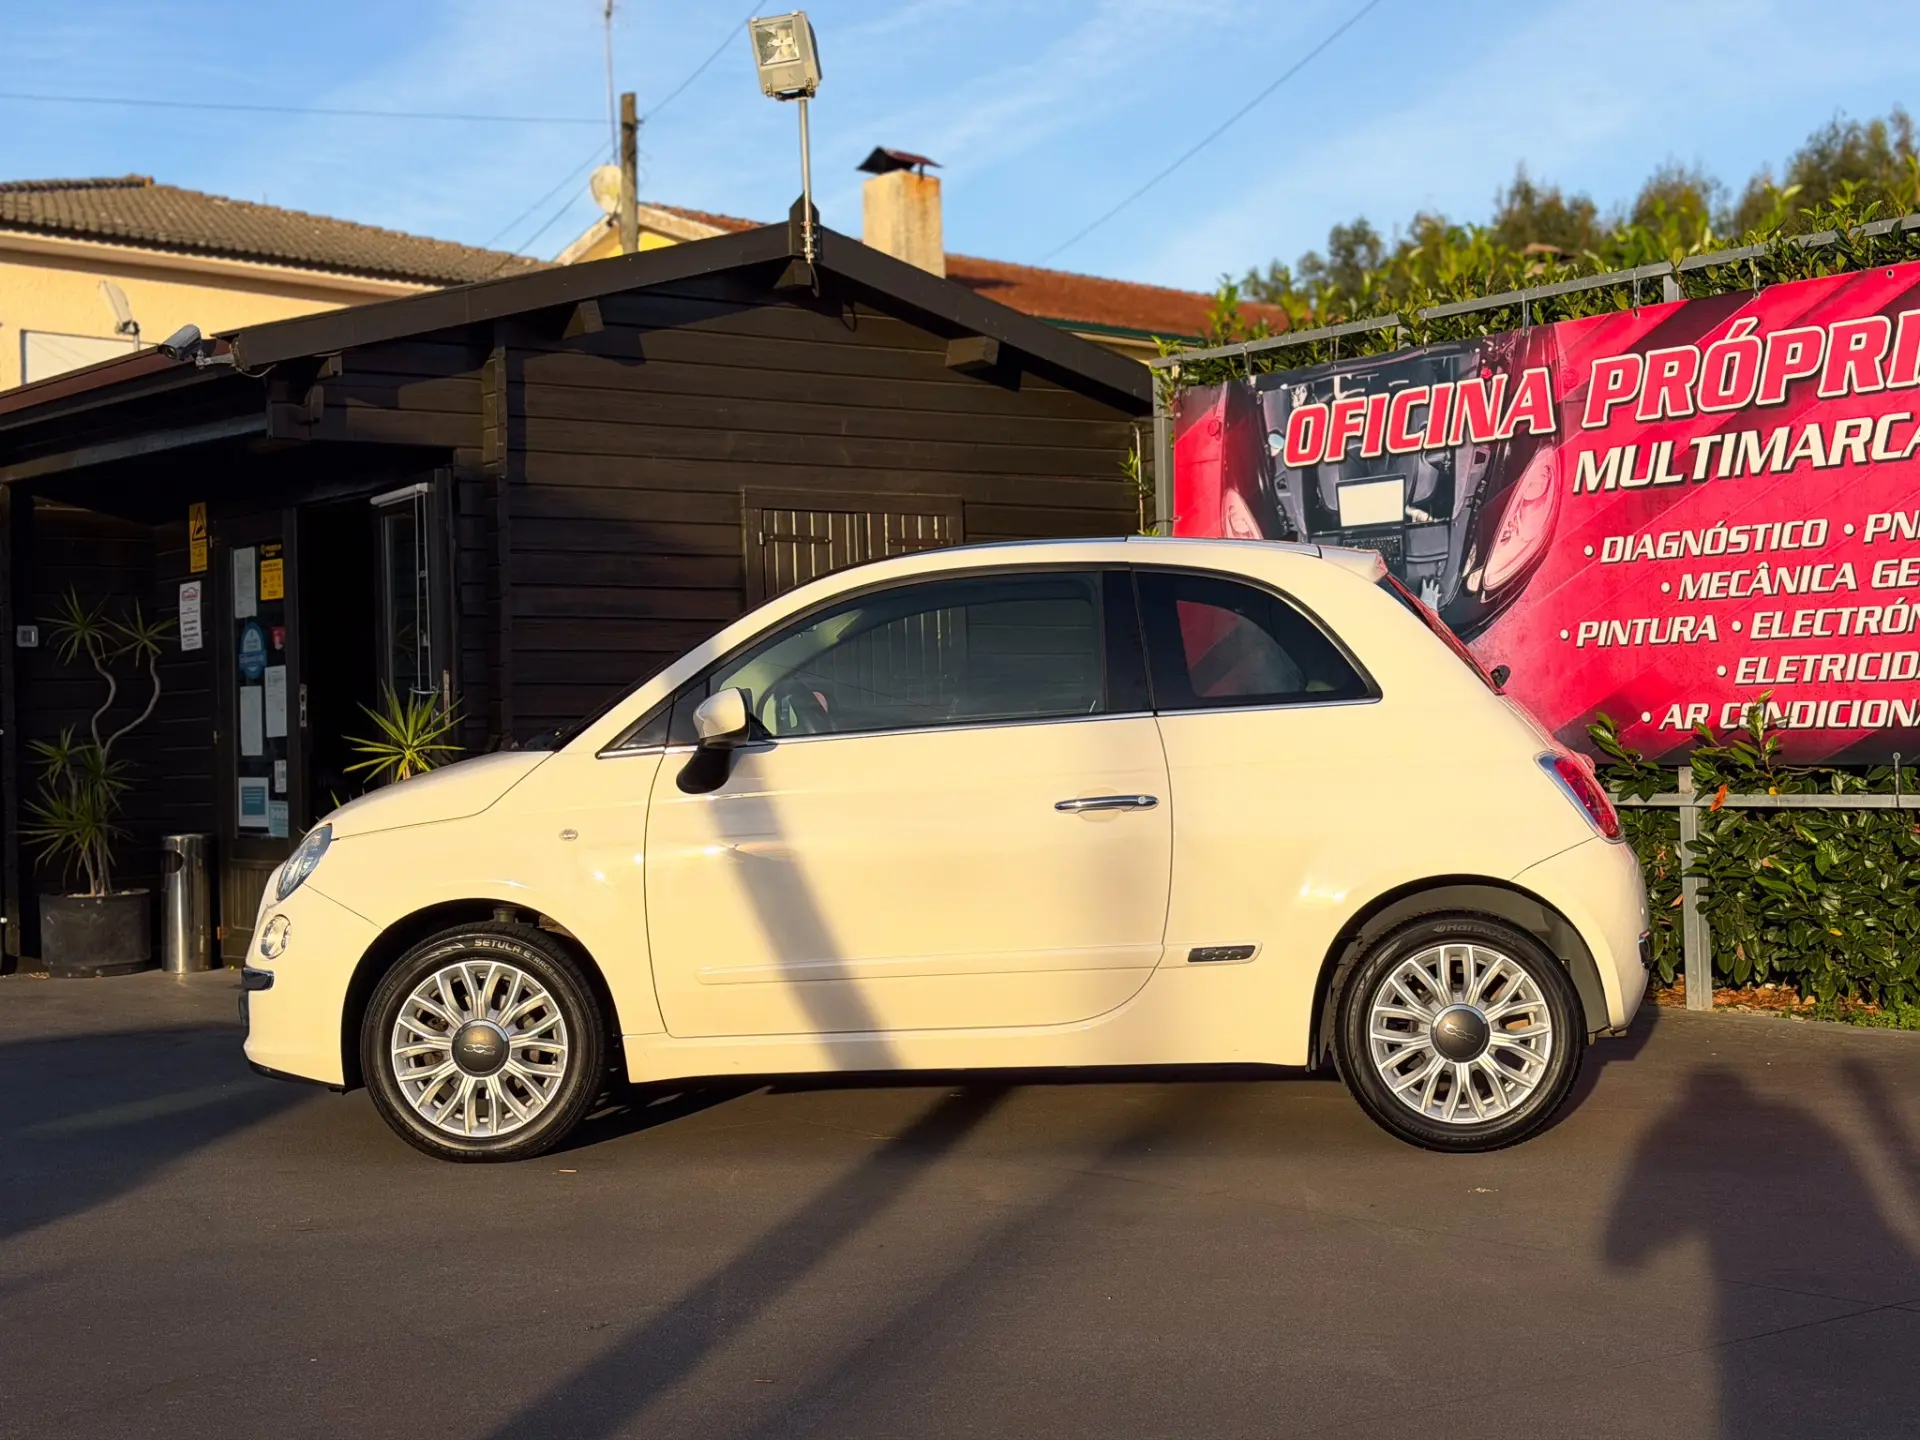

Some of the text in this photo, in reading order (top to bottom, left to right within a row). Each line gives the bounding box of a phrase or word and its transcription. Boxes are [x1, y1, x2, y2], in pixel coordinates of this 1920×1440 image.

[1283, 309, 1920, 468] OFICINA PRÓPRI
[1601, 509, 1920, 564] DIAGNÓSTICO PN
[1678, 561, 1858, 601] MECÂNICA
[1576, 615, 1718, 648] PINTURA
[1735, 651, 1920, 685] ELETRICID
[1659, 699, 1920, 731] AR CONDICION
[474, 939, 521, 953] SETULA
